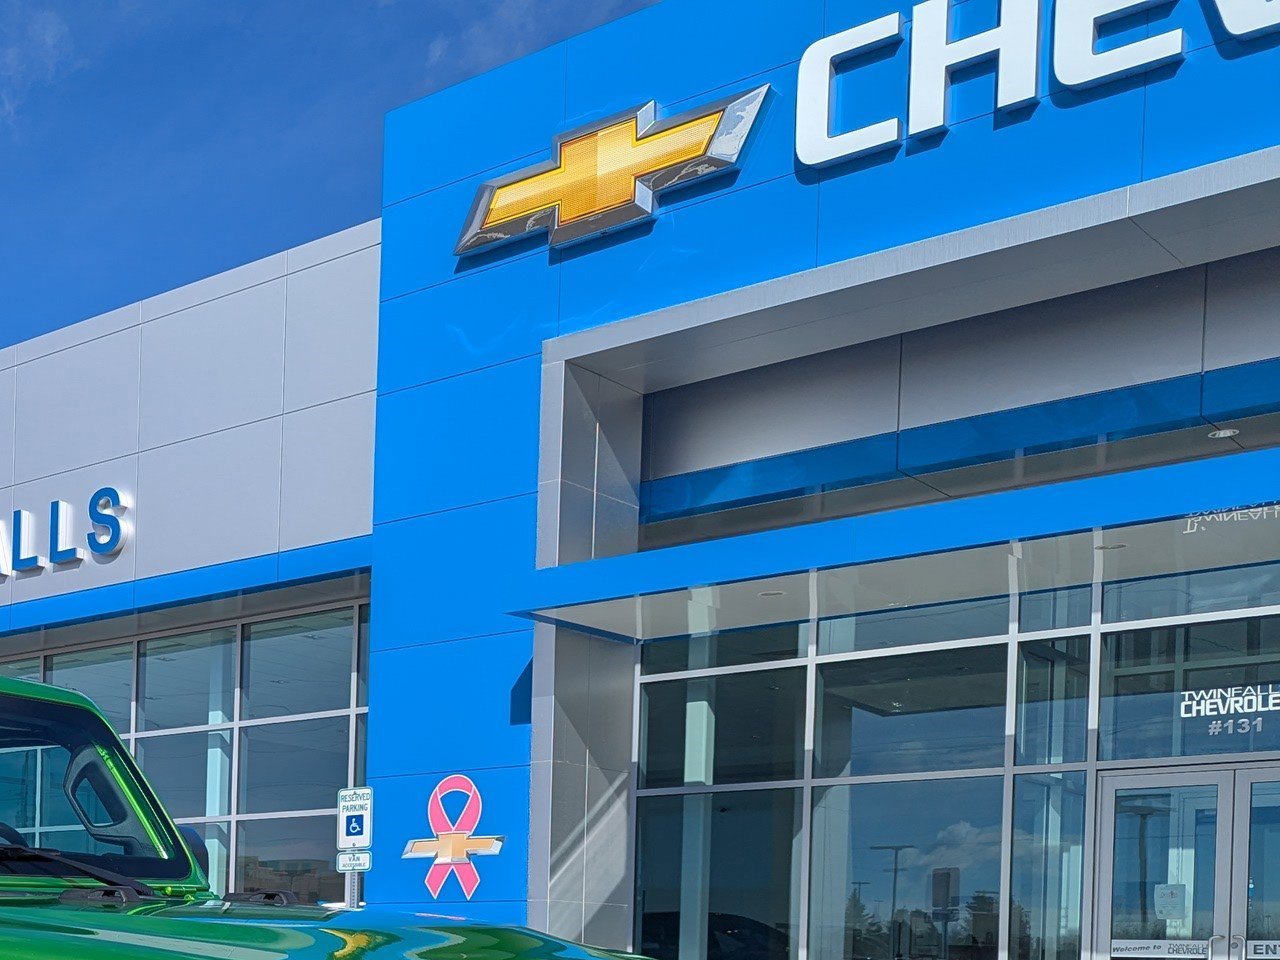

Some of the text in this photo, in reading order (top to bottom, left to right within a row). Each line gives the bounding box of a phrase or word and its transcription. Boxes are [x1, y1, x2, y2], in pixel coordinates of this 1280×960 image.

[796, 0, 1280, 165] CHE
[1181, 684, 1280, 702] TWINFALL
[1208, 717, 1263, 735] #131
[341, 793, 370, 802] RESERVED
[342, 804, 368, 812] PARKING
[1112, 945, 1150, 953] Welcome
[1254, 944, 1280, 955] EN
